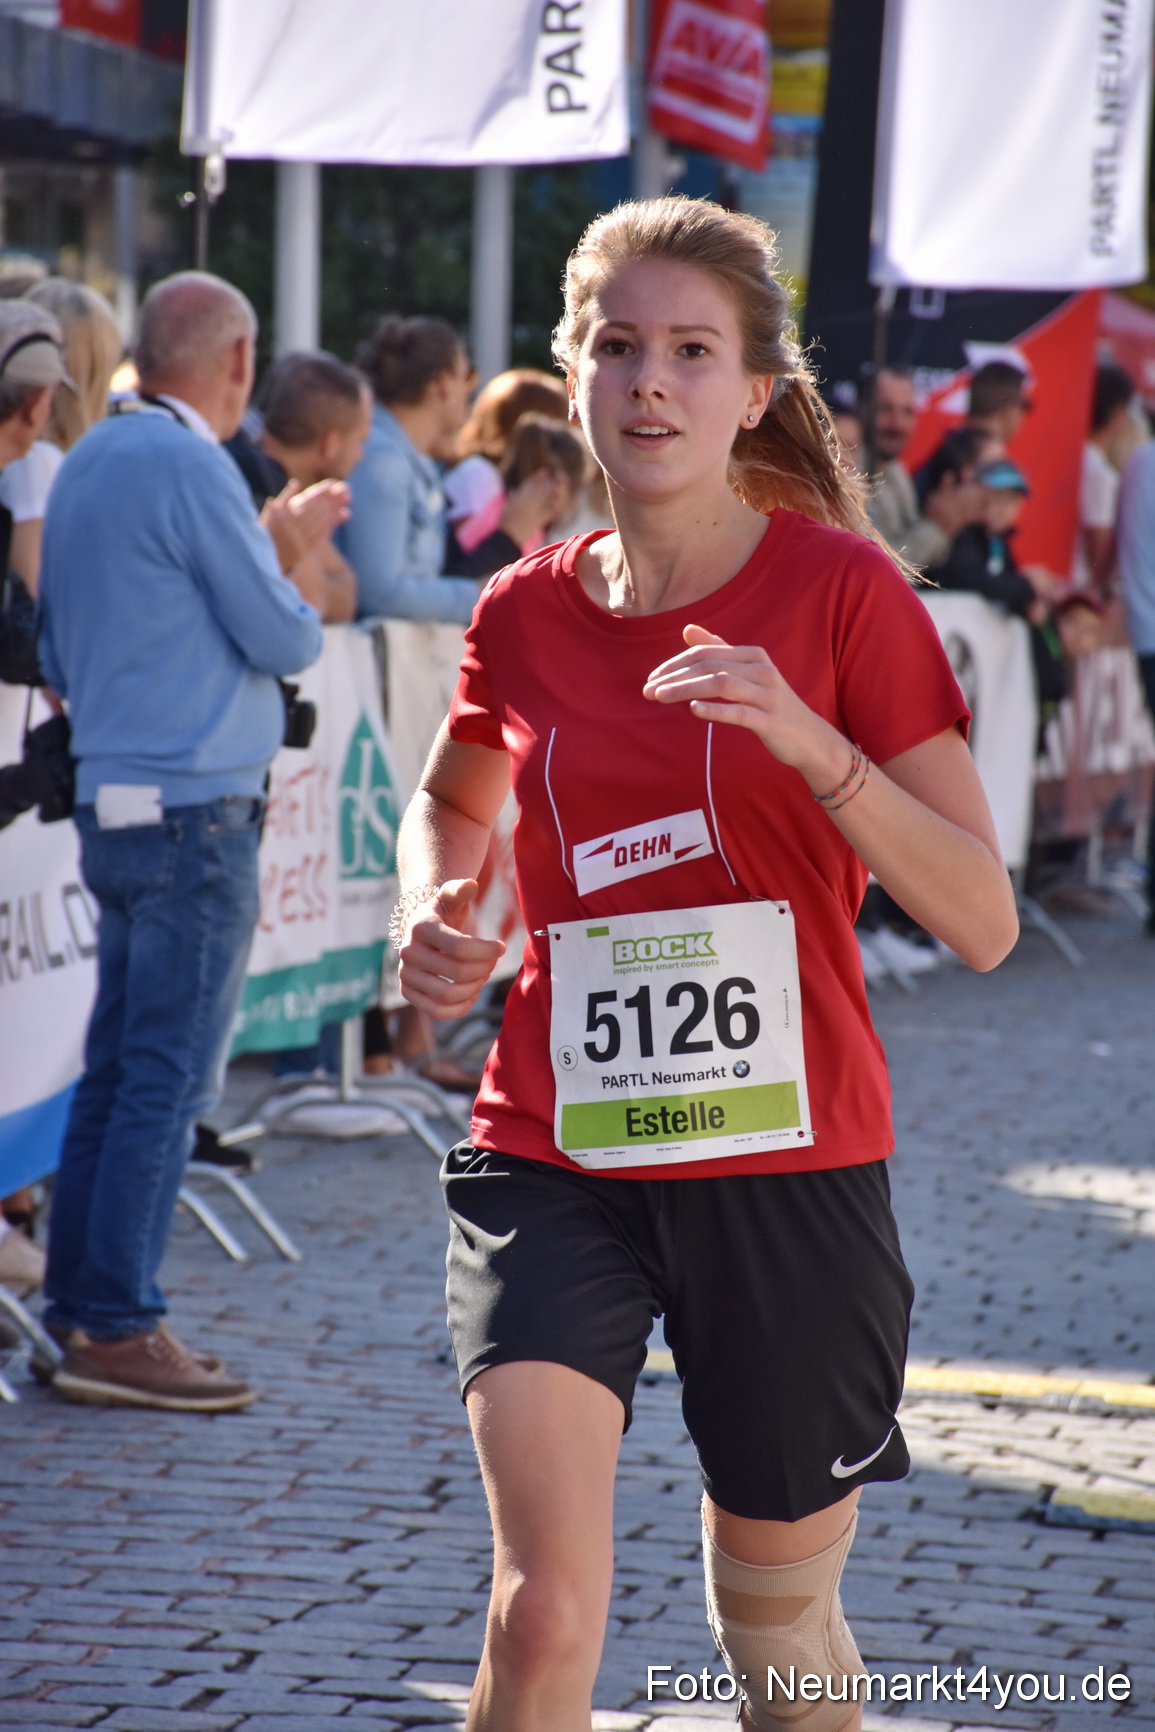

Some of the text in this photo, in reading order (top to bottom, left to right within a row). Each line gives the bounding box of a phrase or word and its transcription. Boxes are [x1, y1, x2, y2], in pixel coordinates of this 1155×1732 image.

[1090, 136, 1119, 257] PARTL
[614, 832, 671, 868] DEHN
[613, 931, 718, 966] BOCK
[613, 958, 720, 975] inspired by smart concepts
[584, 976, 760, 1063] 5126
[562, 1052, 572, 1065] S
[601, 1066, 727, 1090] PARTL Neumarkt
[625, 1101, 726, 1138] Estelle
